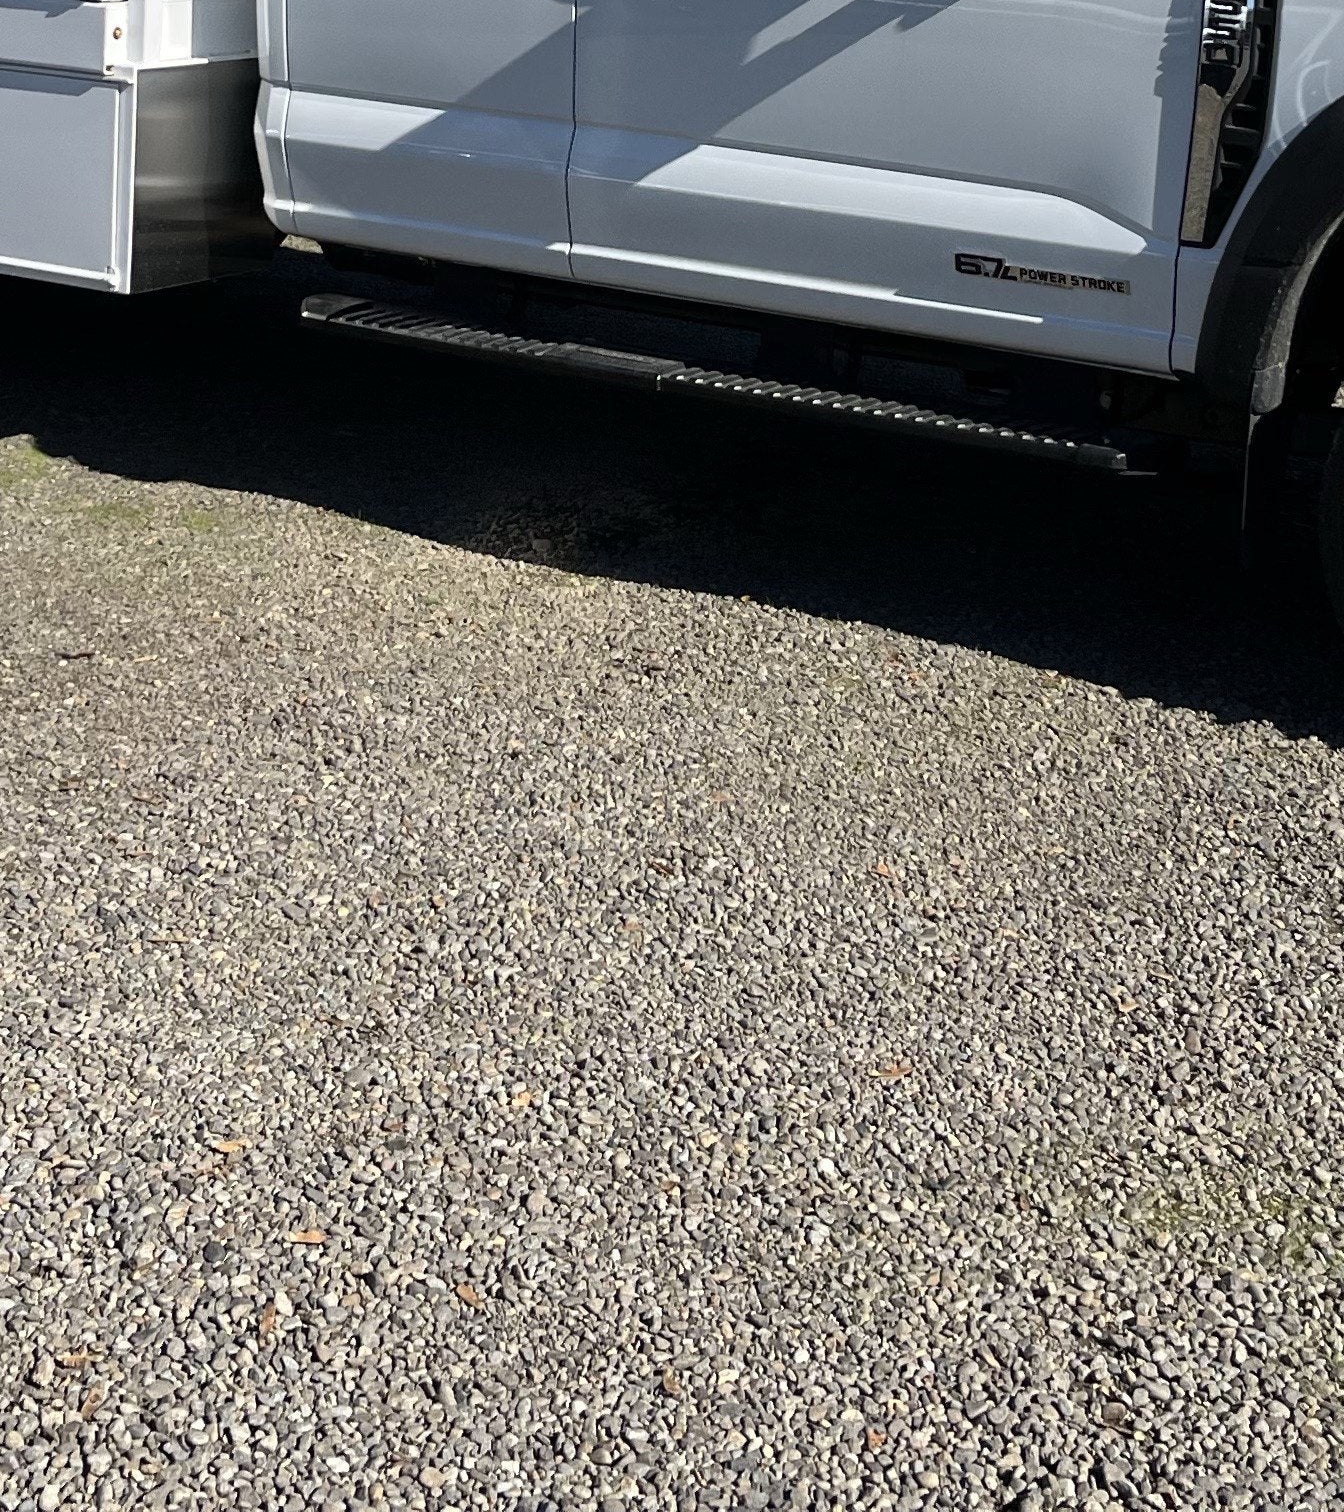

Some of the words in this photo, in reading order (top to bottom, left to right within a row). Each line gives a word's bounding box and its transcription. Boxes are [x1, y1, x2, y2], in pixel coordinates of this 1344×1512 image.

[954, 252, 1018, 282] 6.7L
[1019, 267, 1067, 286] POWER
[1070, 274, 1126, 294] STROKE
